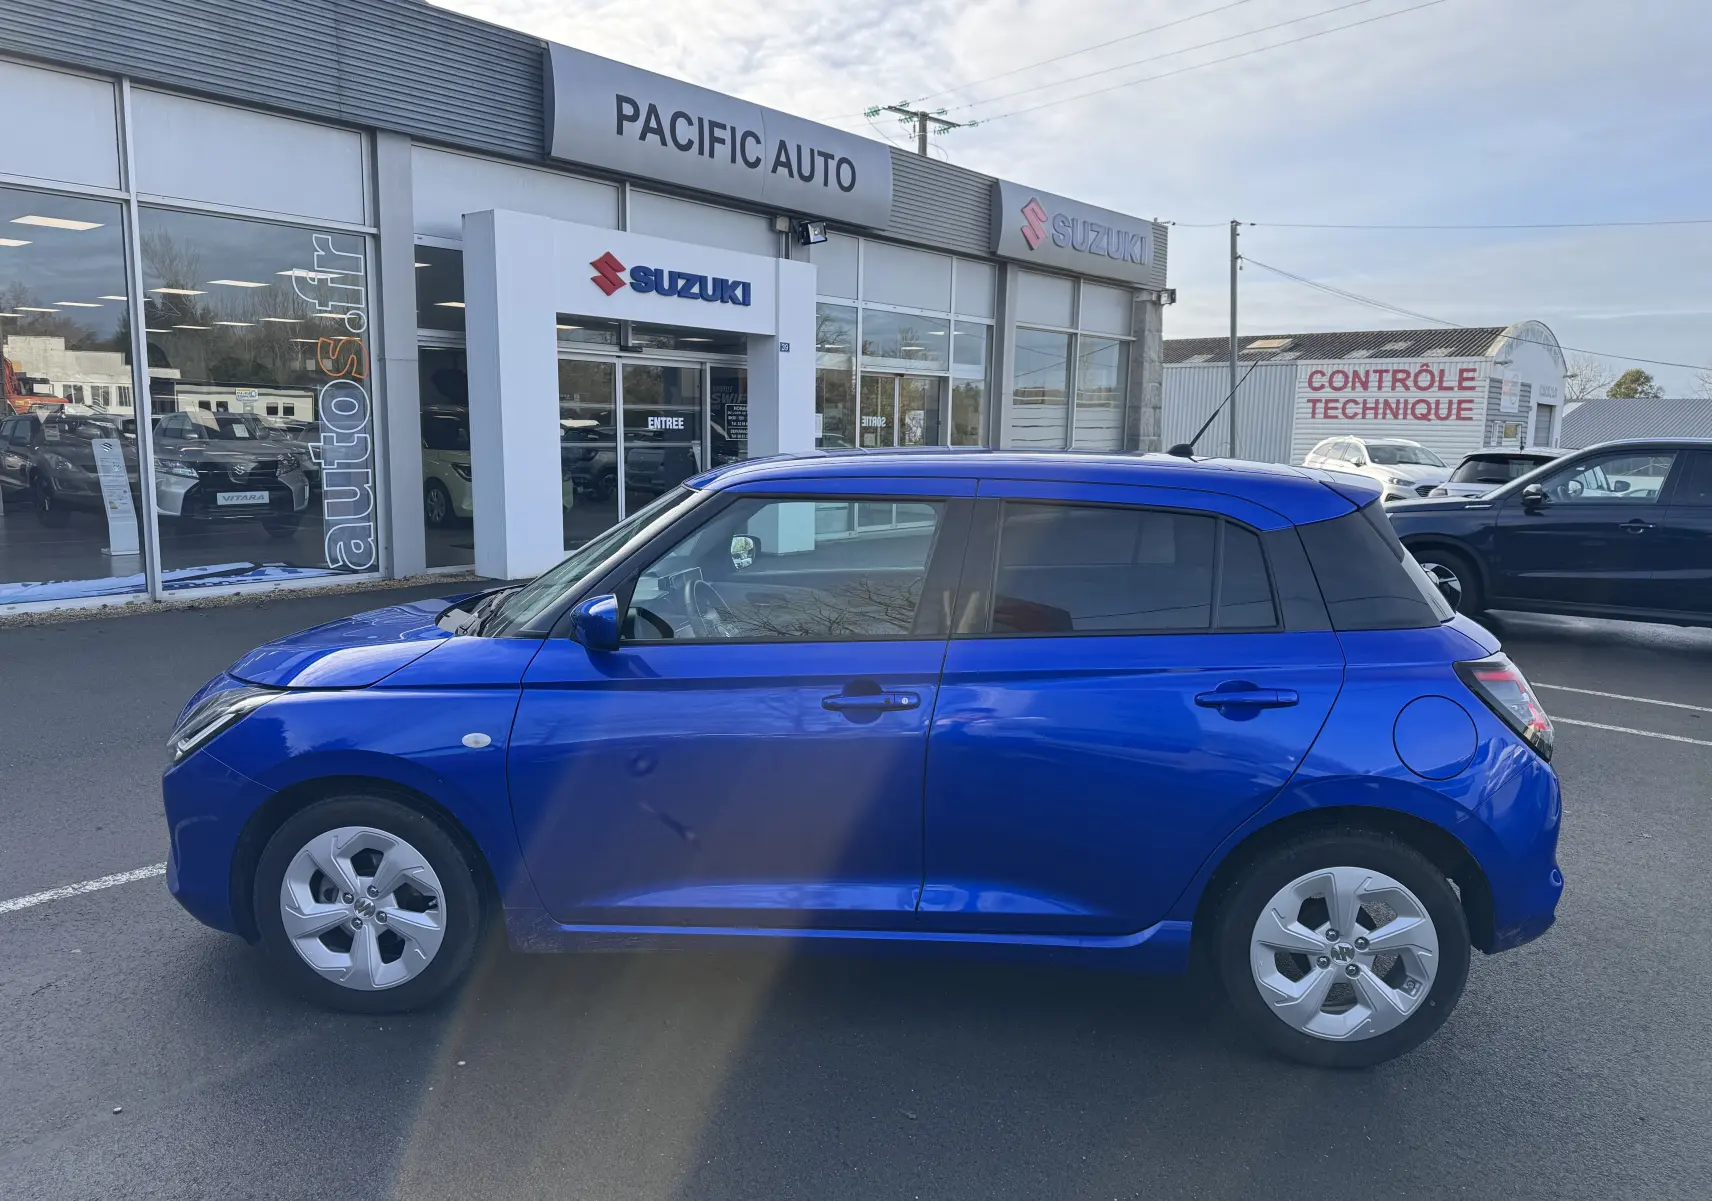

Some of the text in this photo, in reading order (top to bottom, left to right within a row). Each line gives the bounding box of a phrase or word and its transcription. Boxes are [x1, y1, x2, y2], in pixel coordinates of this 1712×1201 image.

[616, 93, 857, 193] PACIFIC AUTO
[1051, 212, 1148, 266] SUZUKI
[629, 265, 752, 307] SUZUKI
[781, 343, 789, 352] 39
[1307, 362, 1477, 392] CONTRÔLE
[292, 233, 376, 571] autos.fr
[711, 392, 748, 404] SWIF
[1306, 398, 1475, 422] TECHNIQUE
[647, 416, 685, 430] ENTREE
[222, 494, 265, 502] VITARA
